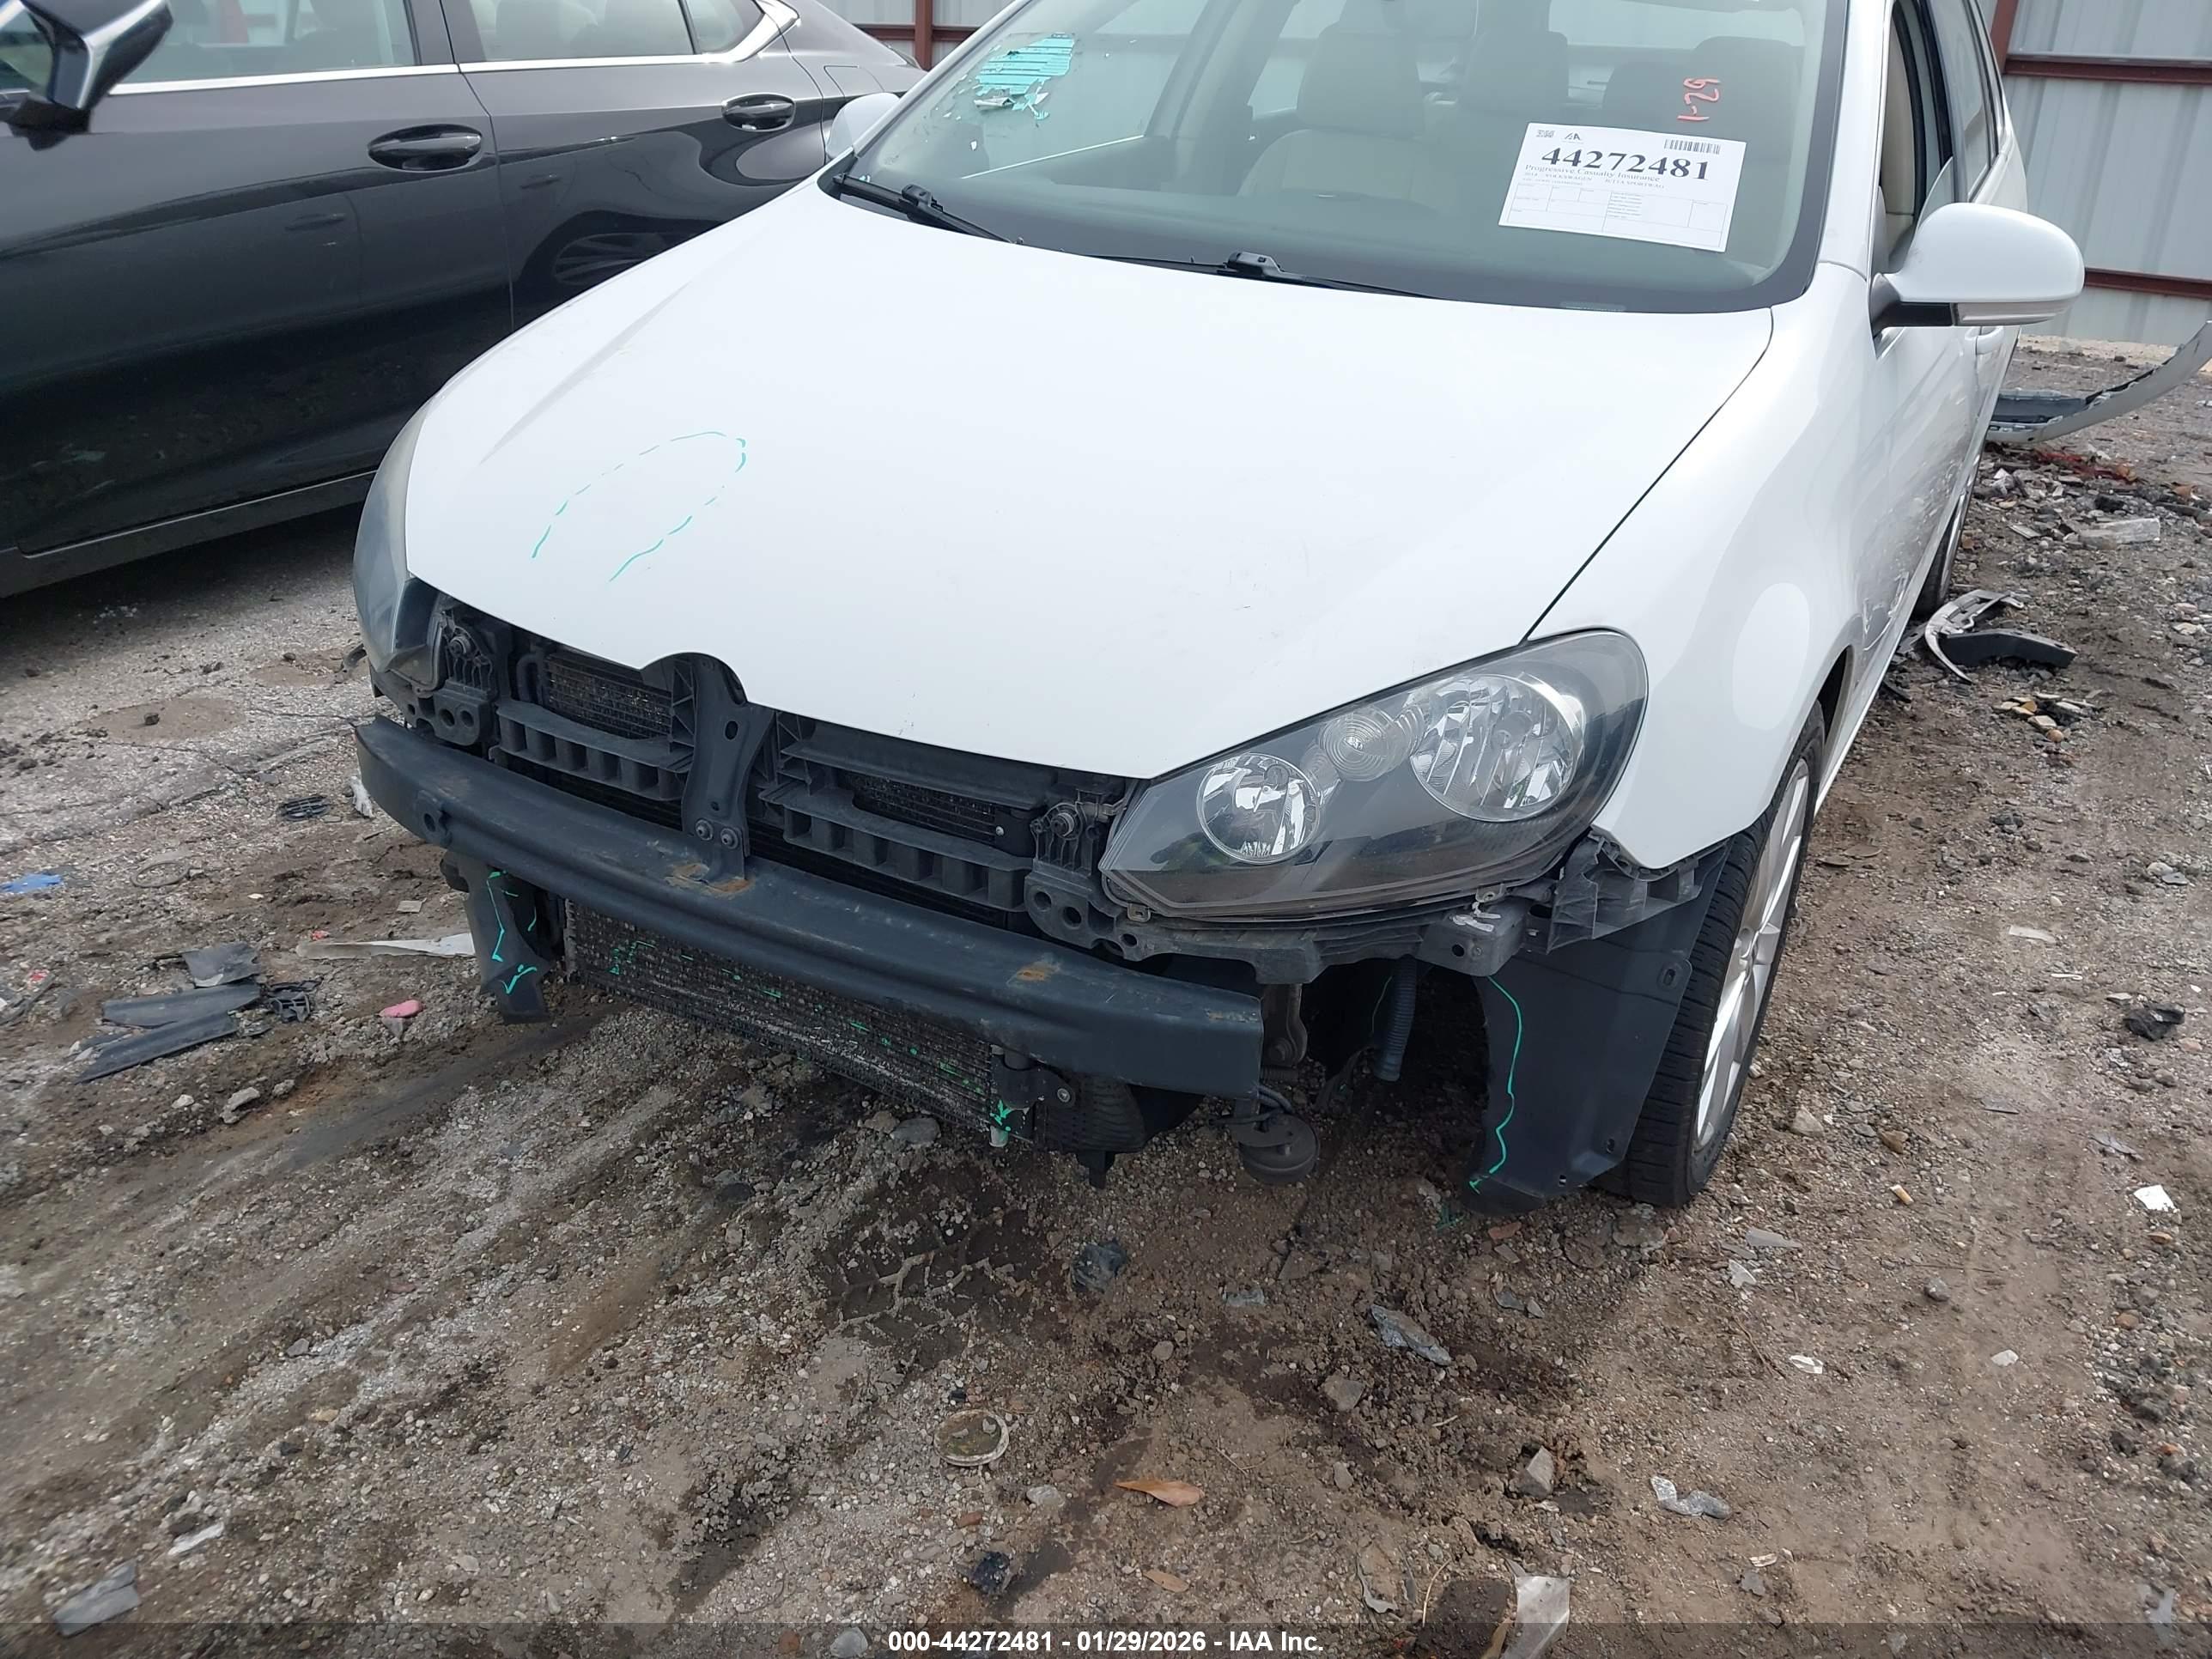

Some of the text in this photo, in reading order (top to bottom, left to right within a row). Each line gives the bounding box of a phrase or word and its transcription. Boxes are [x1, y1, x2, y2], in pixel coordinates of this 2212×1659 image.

[1677, 77, 1720, 121] 1-29
[1525, 164, 1575, 175] Progressive
[1577, 169, 1613, 179] Casualty
[1617, 173, 1661, 182] Insurance
[1541, 147, 1709, 181] 44272481
